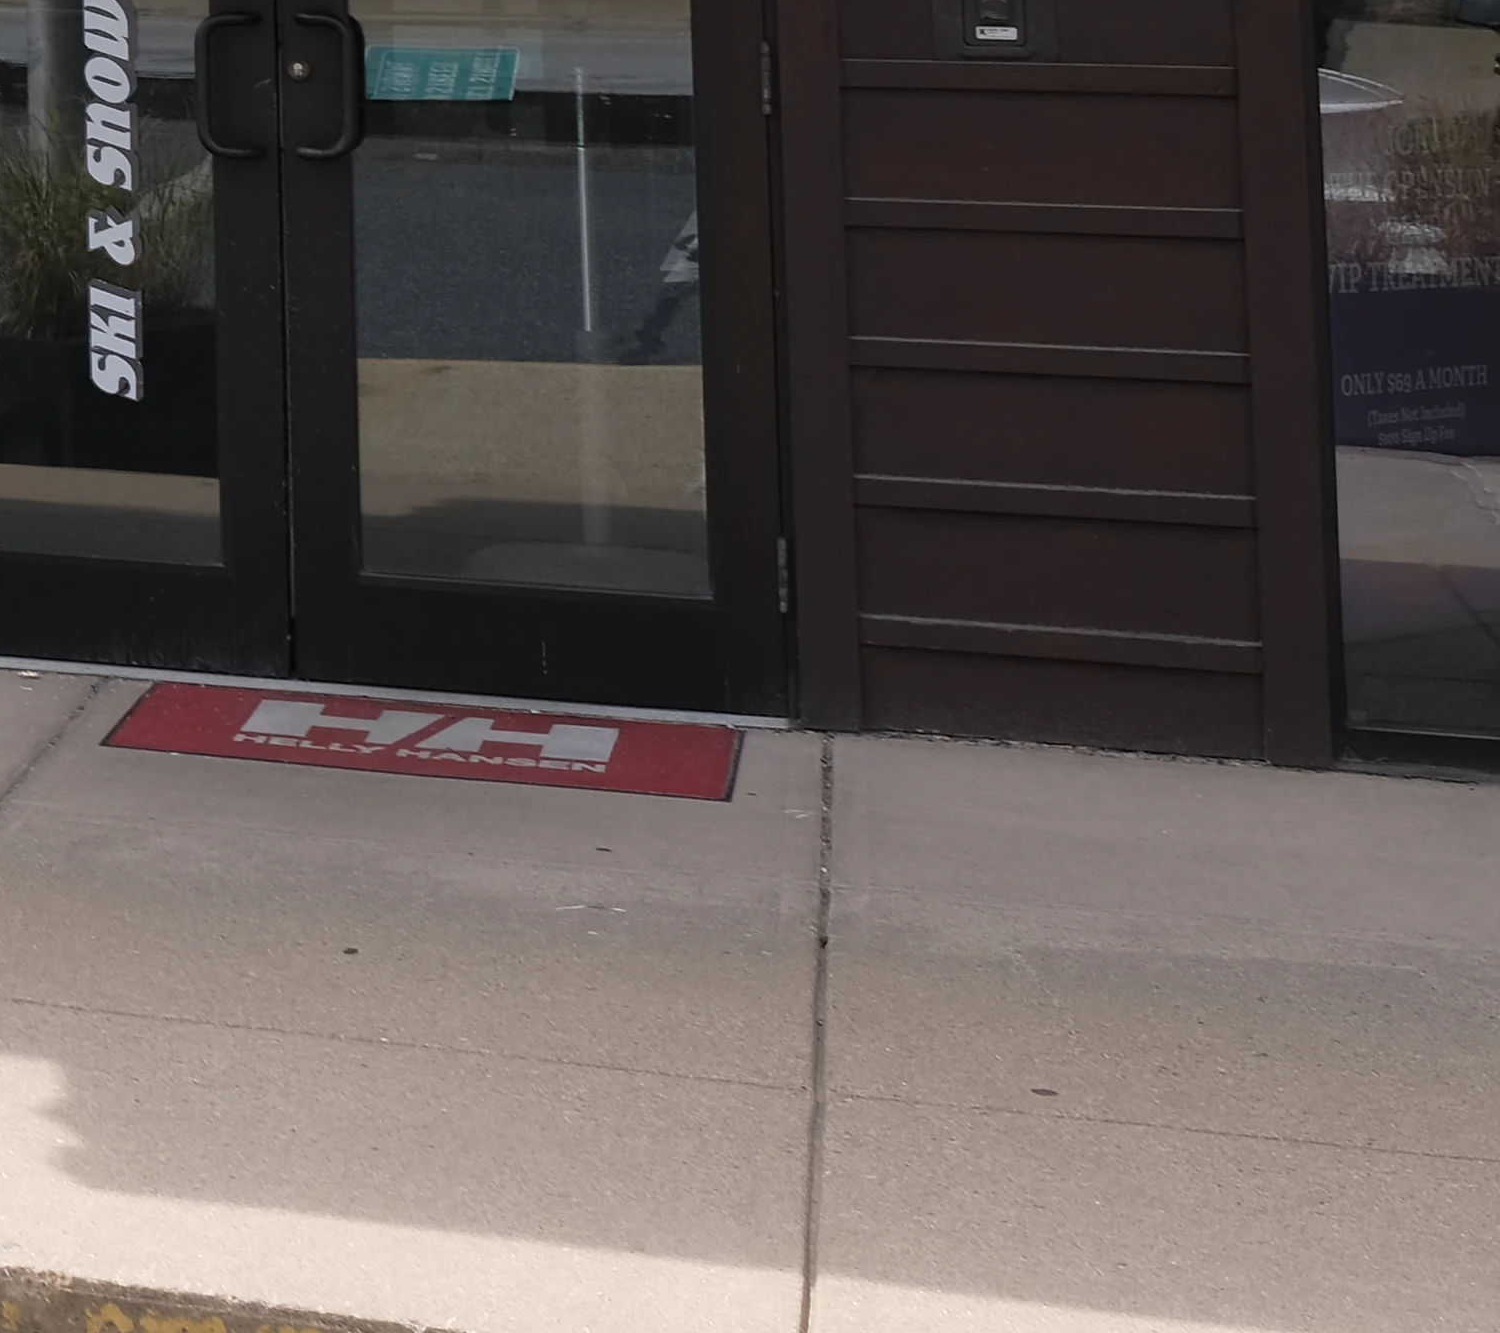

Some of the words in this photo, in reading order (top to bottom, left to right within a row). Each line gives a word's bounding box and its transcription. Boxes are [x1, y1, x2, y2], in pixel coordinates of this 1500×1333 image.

[88, 209, 135, 267] &
[90, 282, 141, 397] SKI
[1340, 371, 1385, 396] ONLY
[1386, 372, 1412, 394] $69
[1415, 369, 1426, 391] A
[1428, 363, 1488, 389] MONTH
[232, 732, 386, 755] HELLY
[396, 747, 608, 775] HANSEN
